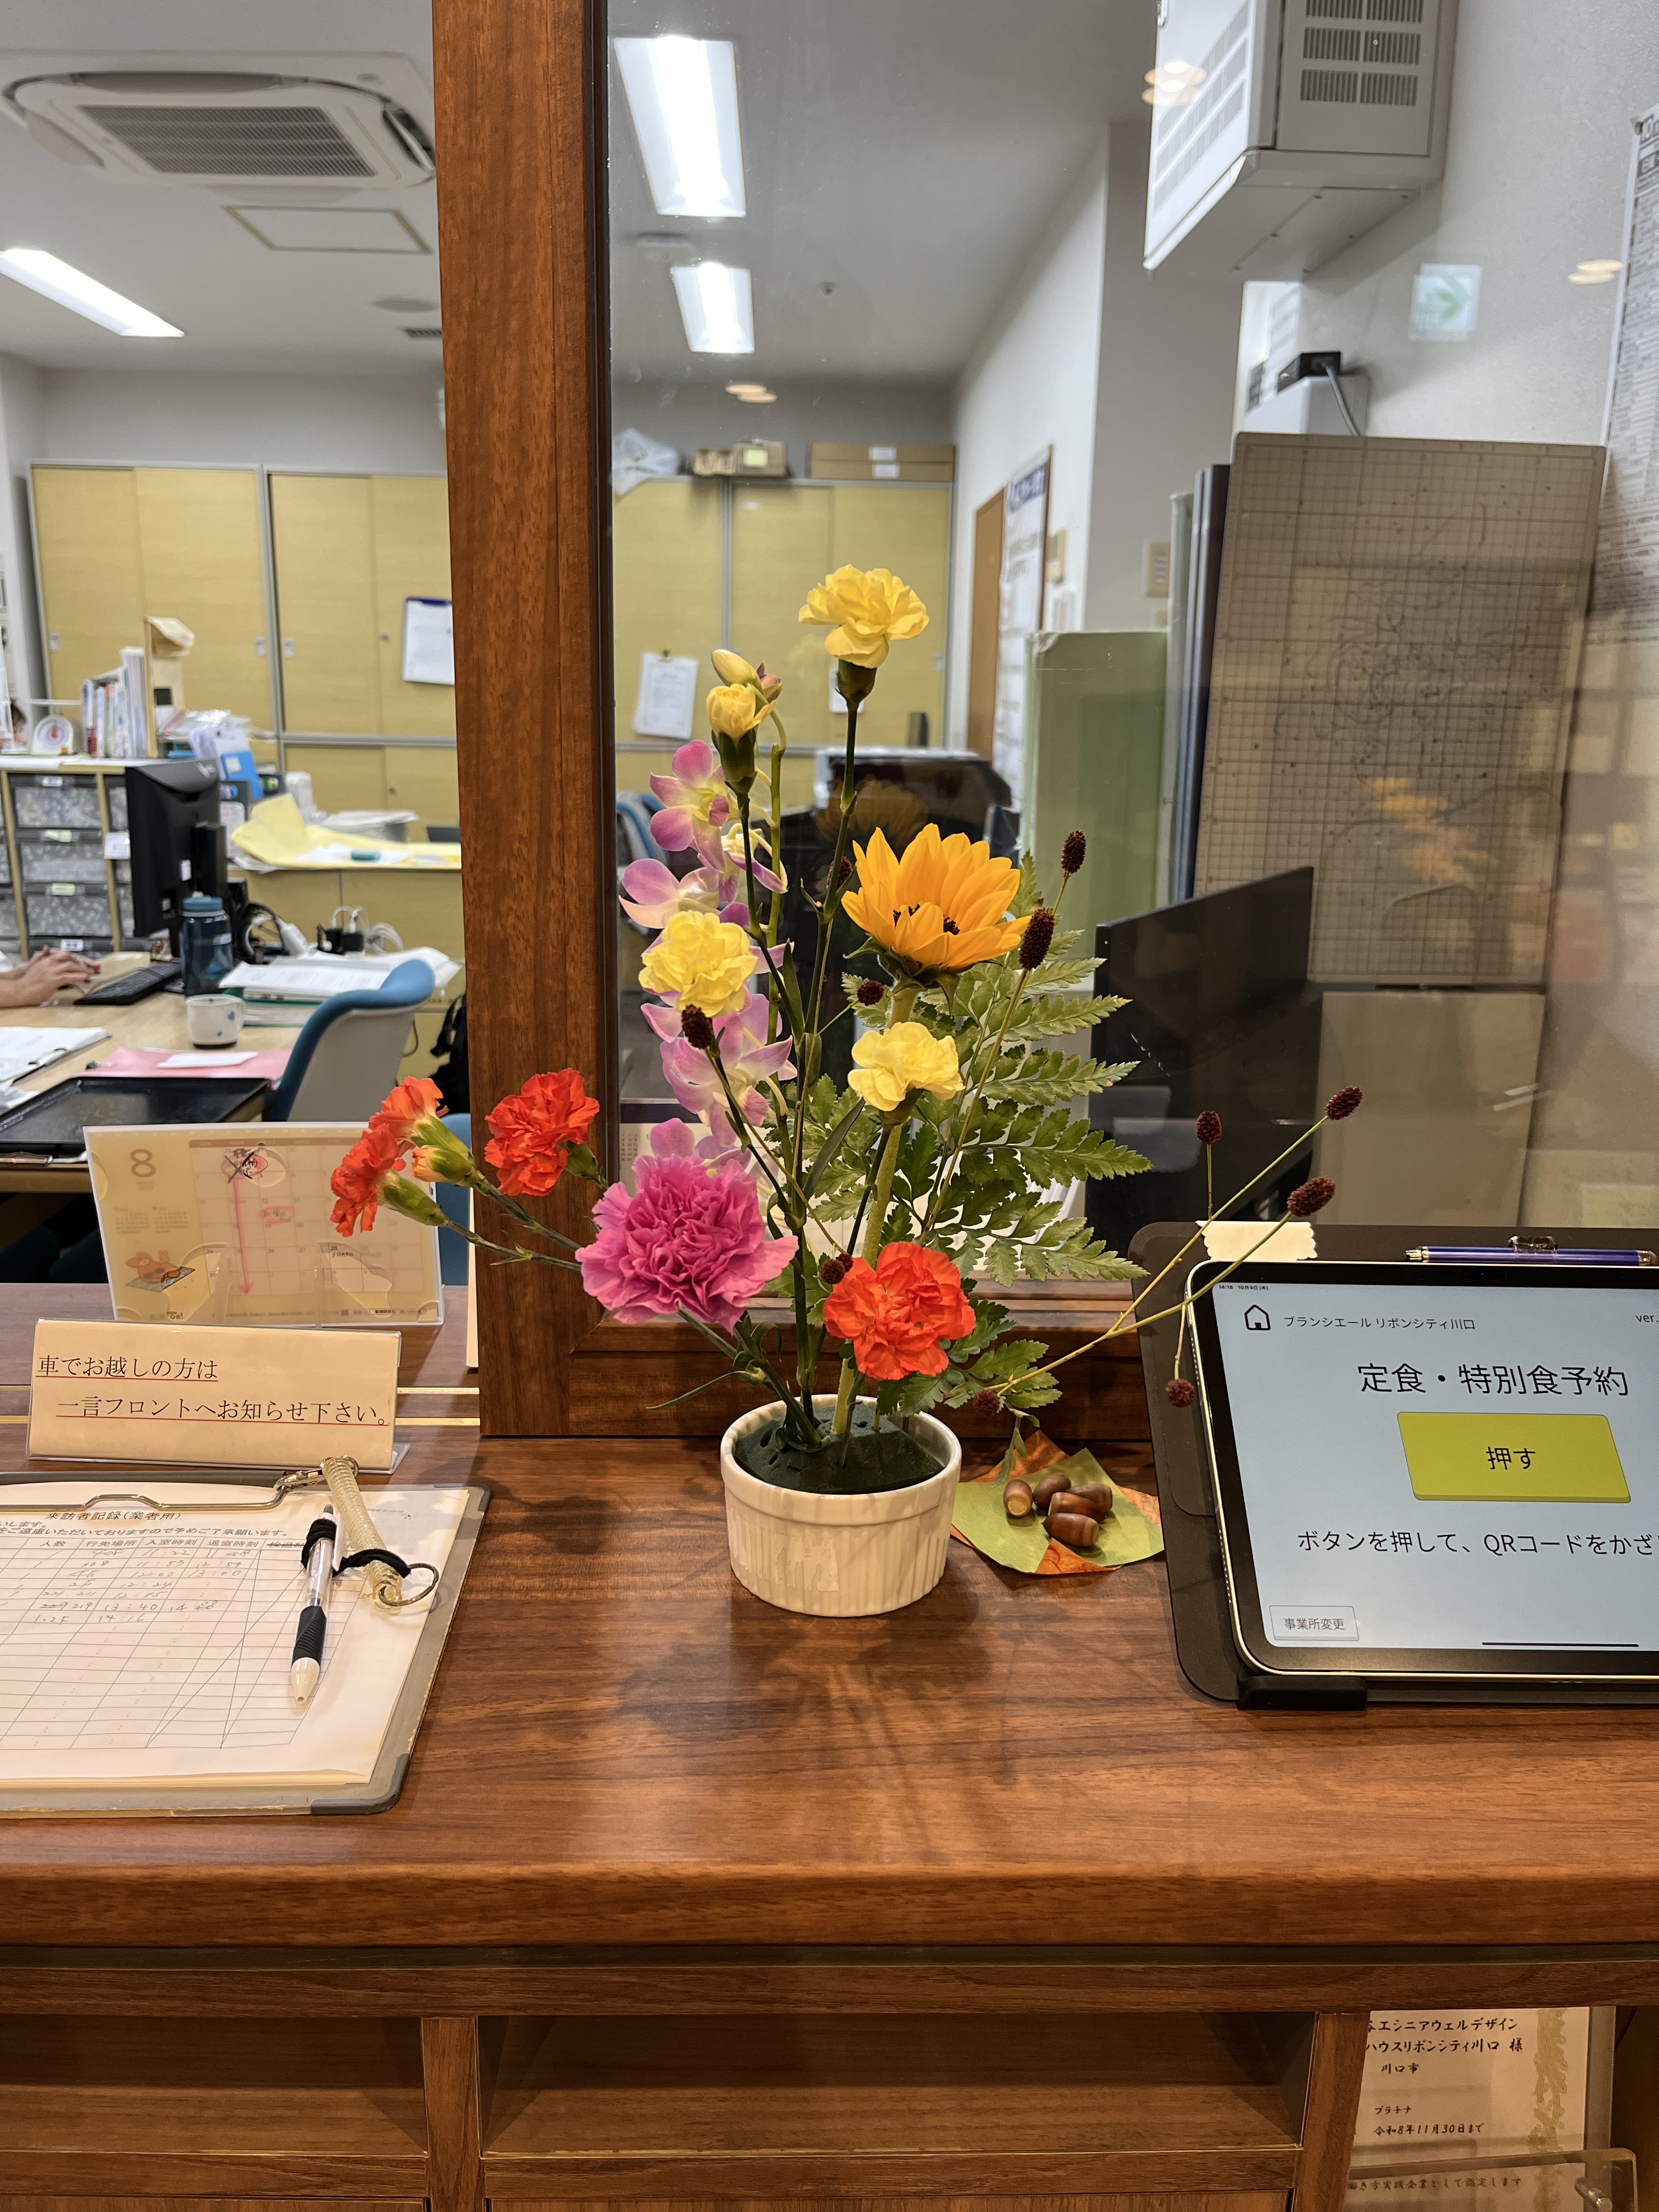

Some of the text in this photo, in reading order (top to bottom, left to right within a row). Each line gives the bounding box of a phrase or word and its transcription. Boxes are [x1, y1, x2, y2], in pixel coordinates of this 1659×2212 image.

[130, 1149, 156, 1177] 8
[1284, 1316, 1372, 1328] ブランシエール
[1635, 1314, 1659, 1323] ver.
[37, 1355, 218, 1380] 車でお越しの方は
[1357, 1363, 1628, 1396] 定食・特別食予約
[58, 1396, 386, 1427] 一言フロントへお知らせ下さい。
[1486, 1446, 1537, 1471] 押す
[208, 1539, 259, 1548] 退室時刻
[1297, 1530, 1659, 1556] ボタンを押して、QRコードをかざ
[1283, 1617, 1346, 1632] 事業所変更
[1509, 2037, 1523, 2052] 様
[1381, 2063, 1419, 2074] 川口市
[1374, 2106, 1412, 2114] プラチナ
[1373, 2123, 1485, 2136] 令和8年11月30日まで
